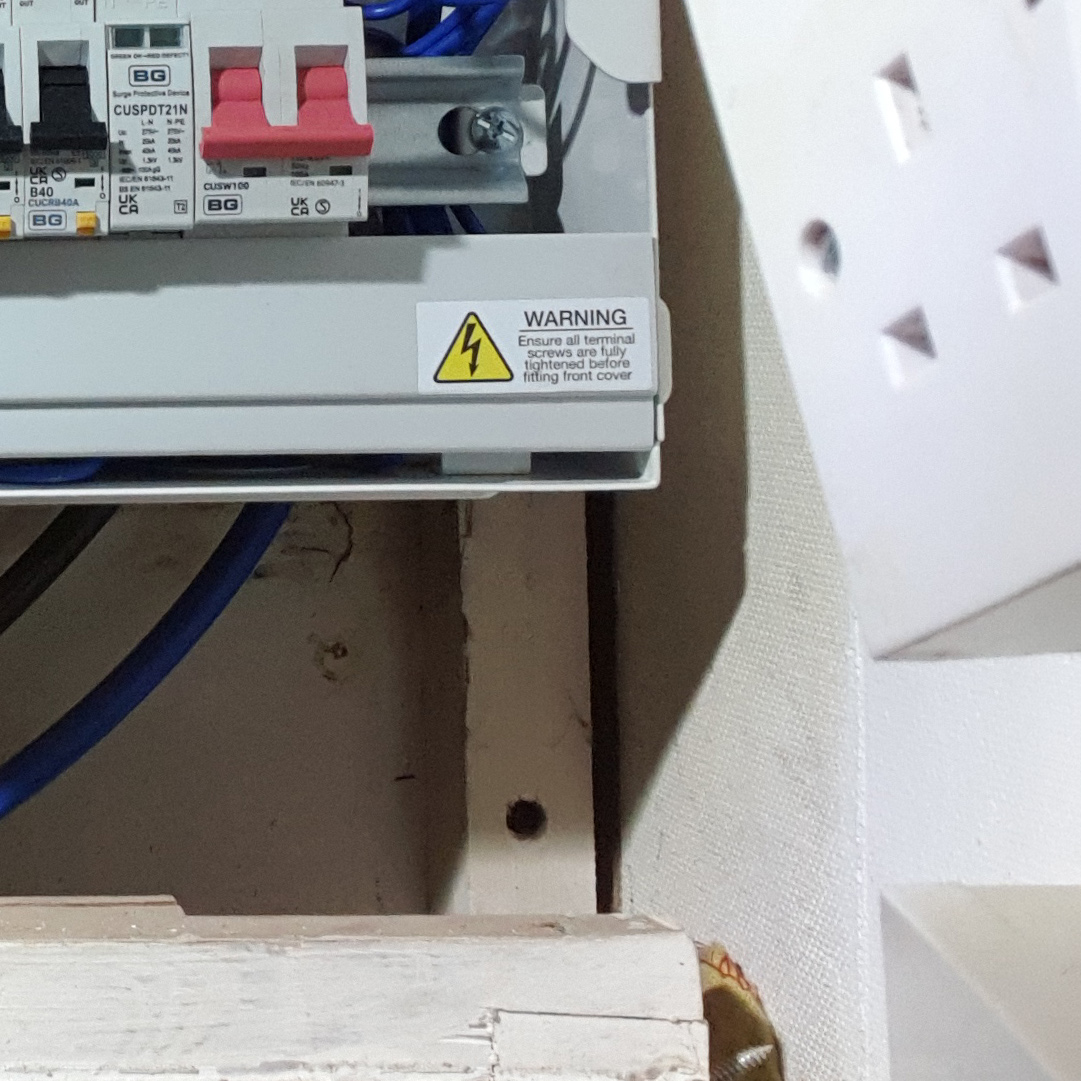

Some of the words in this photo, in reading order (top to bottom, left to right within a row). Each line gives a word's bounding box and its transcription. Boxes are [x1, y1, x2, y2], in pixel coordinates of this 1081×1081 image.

[133, 69, 166, 82] BG
[114, 103, 188, 116] CUSPDT21N
[30, 167, 47, 175] UK
[30, 177, 48, 185] CA
[203, 182, 250, 191] CUSW100
[31, 187, 53, 198] B40
[28, 199, 79, 207] CUCRB40A
[119, 194, 138, 204] UK
[291, 197, 308, 206] UK
[119, 204, 139, 215] CA
[207, 199, 239, 211] BG
[291, 206, 309, 216] CA
[32, 215, 63, 226] BG
[523, 308, 627, 327] WARNING
[518, 335, 562, 347] Ensure
[566, 334, 580, 346] all
[584, 333, 635, 345] terminal
[527, 348, 573, 359] screws
[576, 348, 597, 357] are
[601, 346, 627, 359] fully
[524, 358, 585, 372] tightened
[589, 357, 630, 369] before
[523, 370, 559, 385] fitting
[563, 370, 593, 382] front
[596, 371, 633, 381] cover
